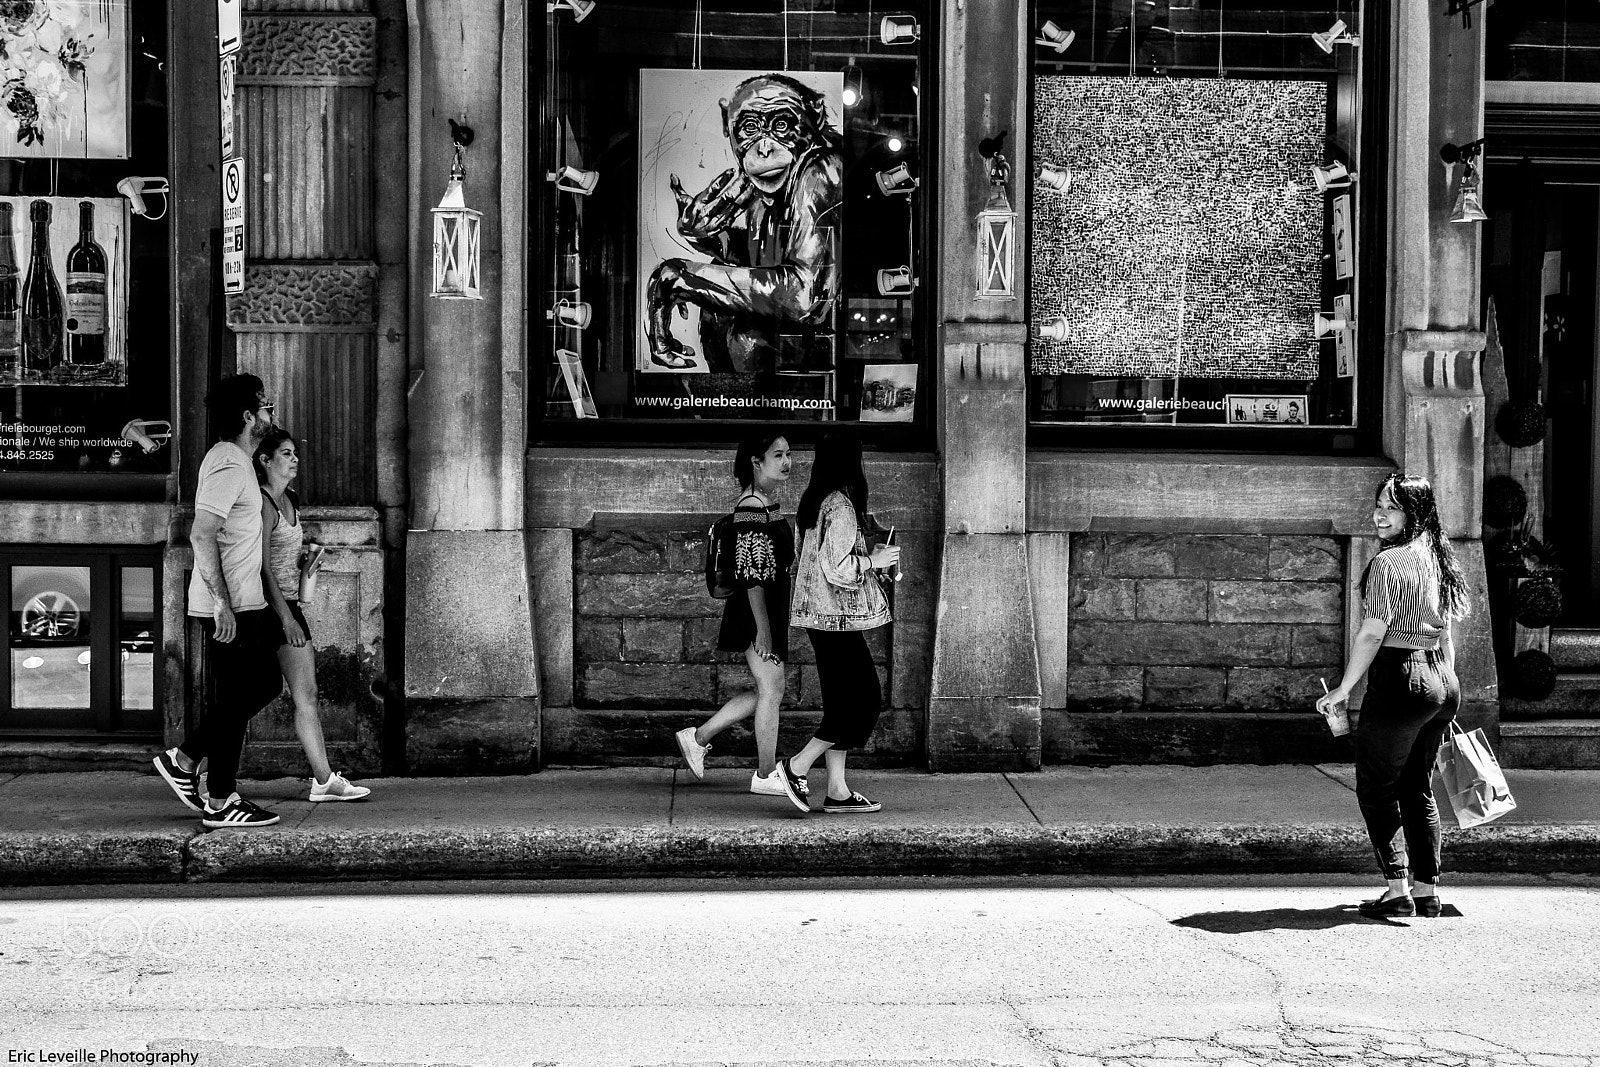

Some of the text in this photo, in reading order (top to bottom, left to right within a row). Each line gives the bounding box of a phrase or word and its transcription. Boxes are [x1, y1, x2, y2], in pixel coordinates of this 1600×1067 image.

[634, 394, 833, 411] www.galeriebeauchamp.com
[38, 436, 56, 447] We
[58, 436, 80, 449] ship
[82, 437, 133, 448] worldwide
